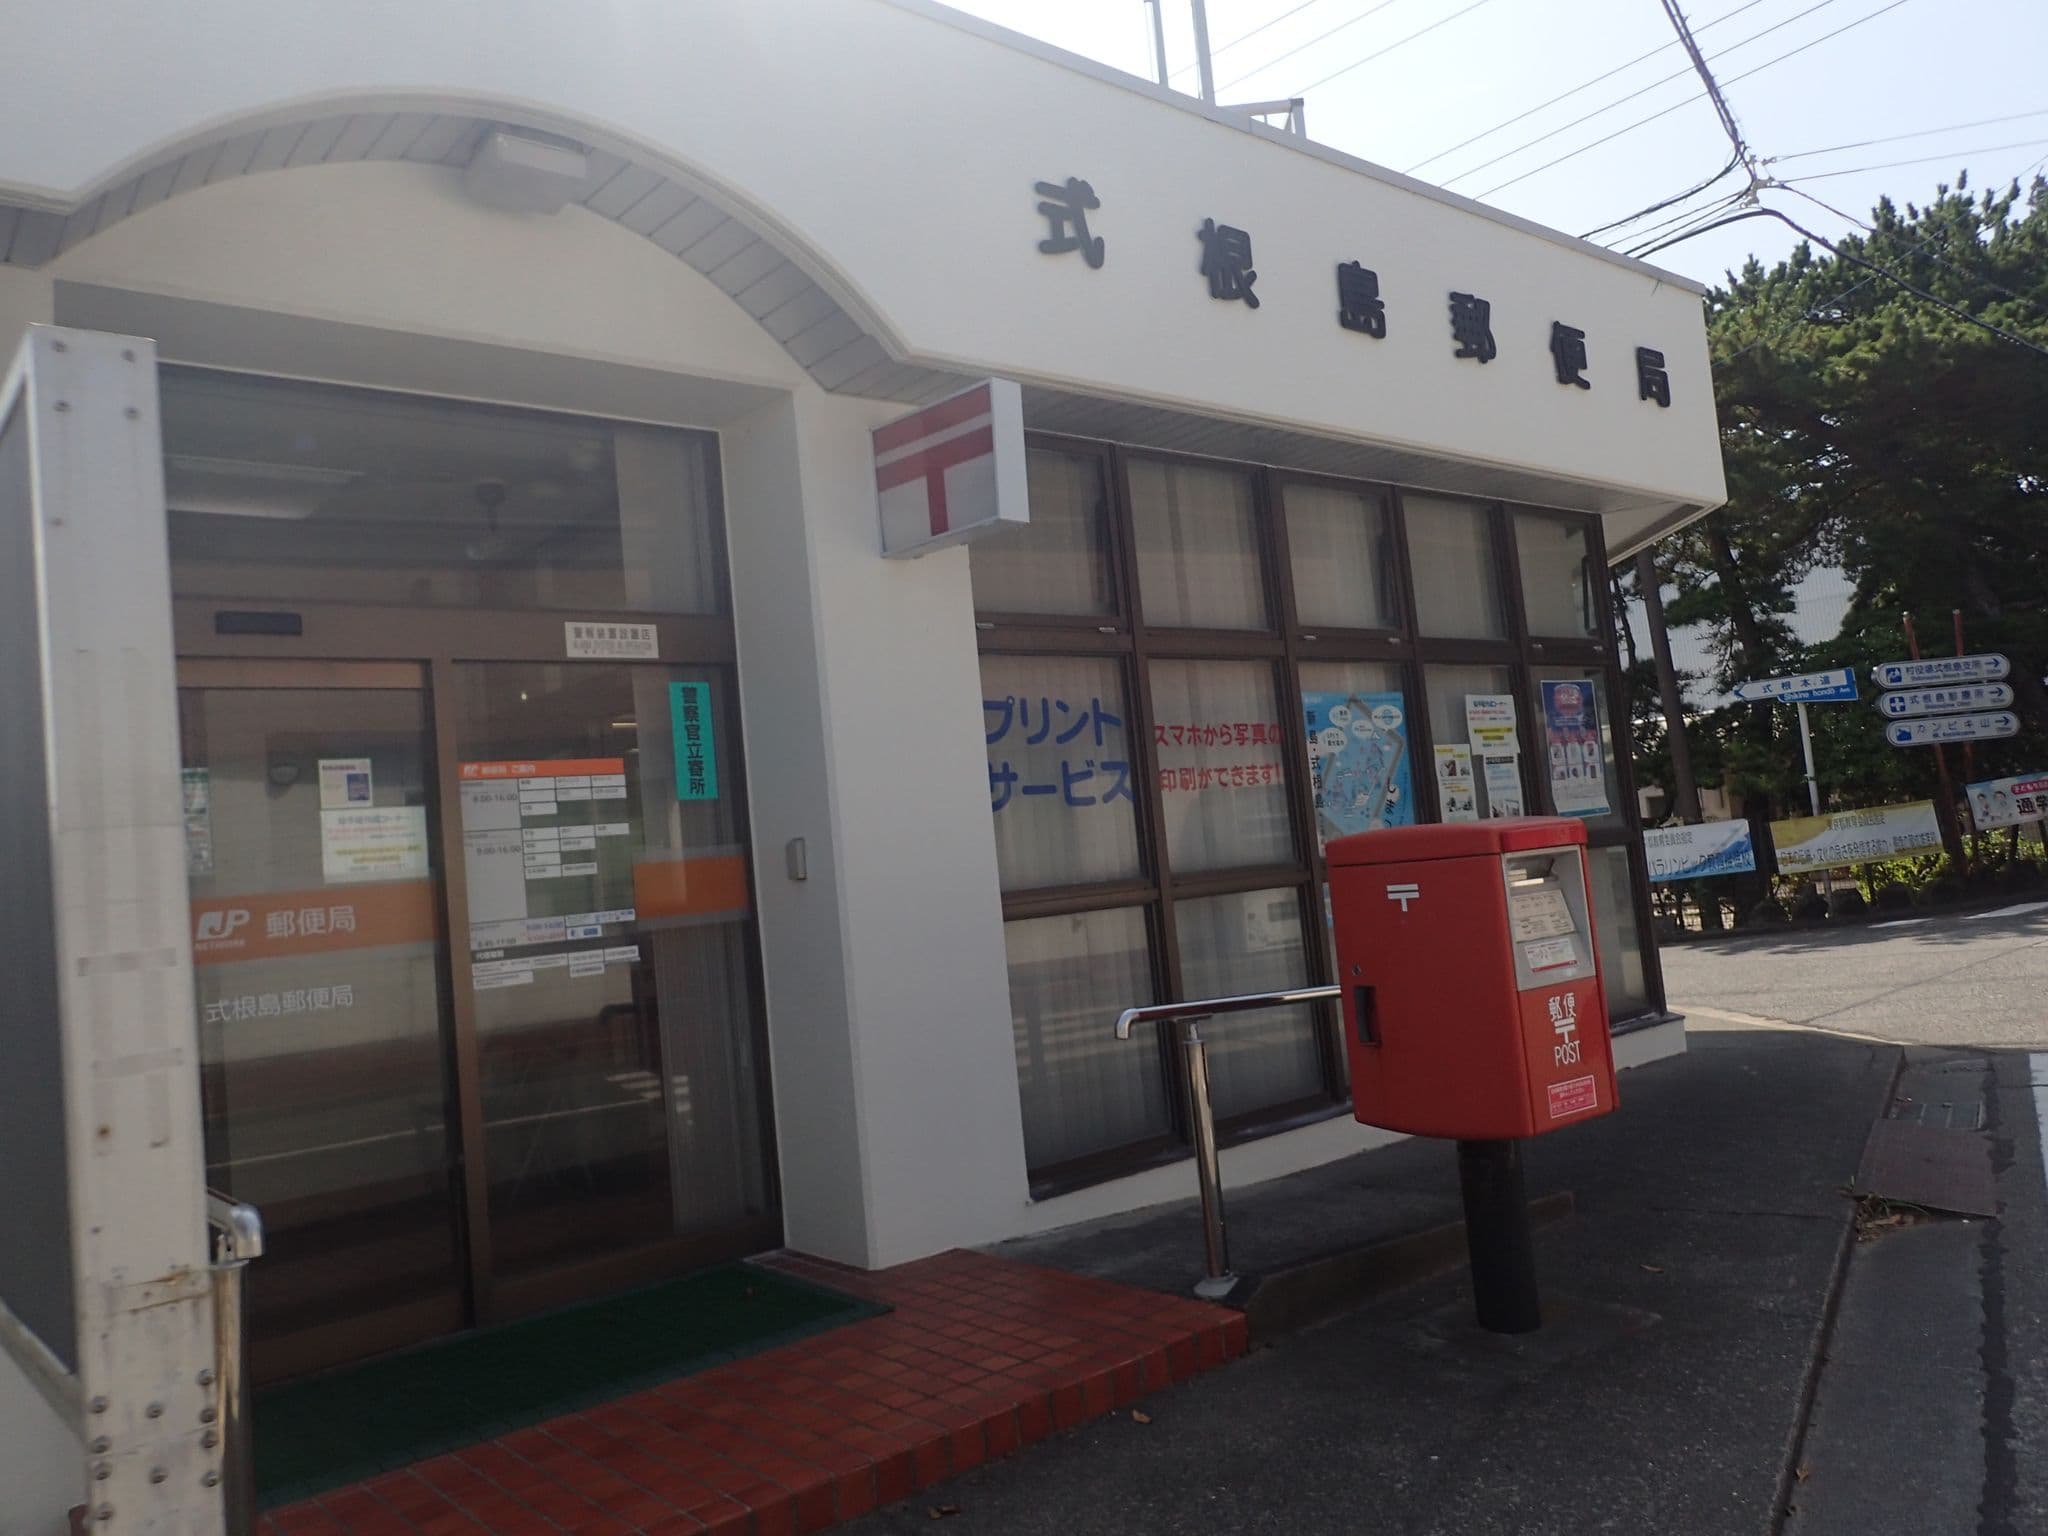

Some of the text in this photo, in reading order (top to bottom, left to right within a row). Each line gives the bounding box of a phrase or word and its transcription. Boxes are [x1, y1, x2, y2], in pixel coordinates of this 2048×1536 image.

[1035, 177, 1671, 408] 式根島郵便局
[983, 696, 1122, 747] プリント
[1153, 722, 1283, 747] スマホから写真の
[988, 760, 1136, 812] サービス
[1158, 762, 1281, 792] 印刷ができます!
[266, 904, 357, 939] 郵便局
[205, 984, 354, 1025] 式根島郵便局
[1548, 991, 1577, 1022] 郵便
[1554, 1040, 1581, 1069] POST
